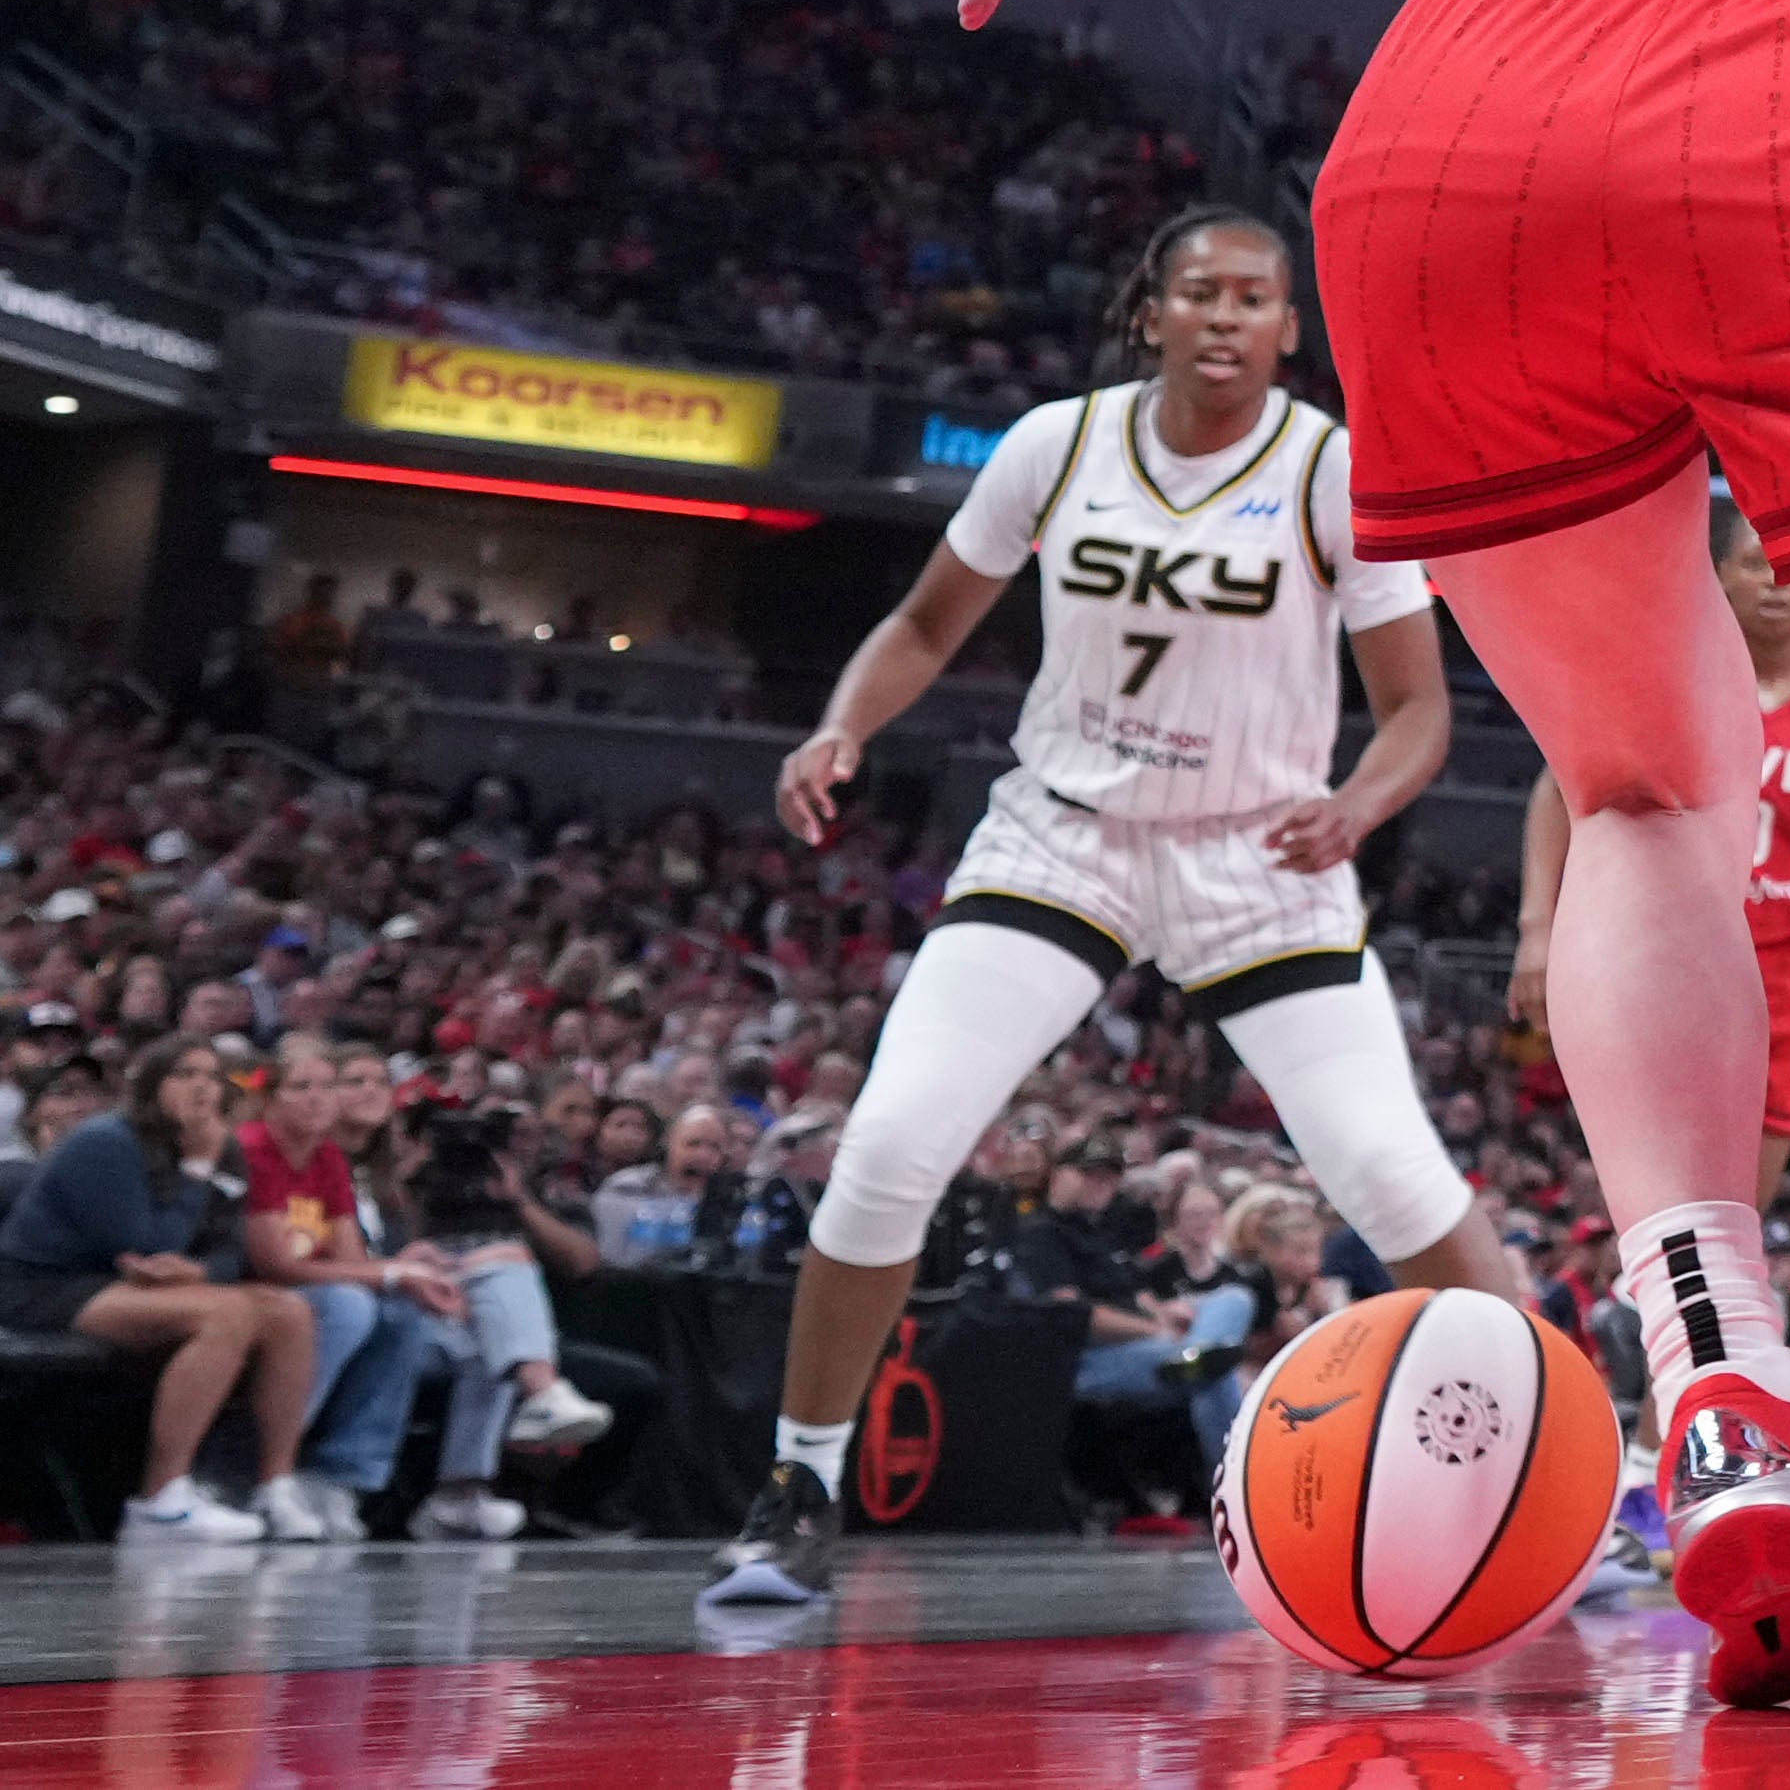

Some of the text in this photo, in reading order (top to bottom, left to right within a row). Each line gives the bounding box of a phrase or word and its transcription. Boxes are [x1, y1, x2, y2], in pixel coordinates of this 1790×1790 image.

[393, 343, 728, 426] Koorsen
[1060, 536, 1281, 618] SKY
[1120, 633, 1173, 698] 7
